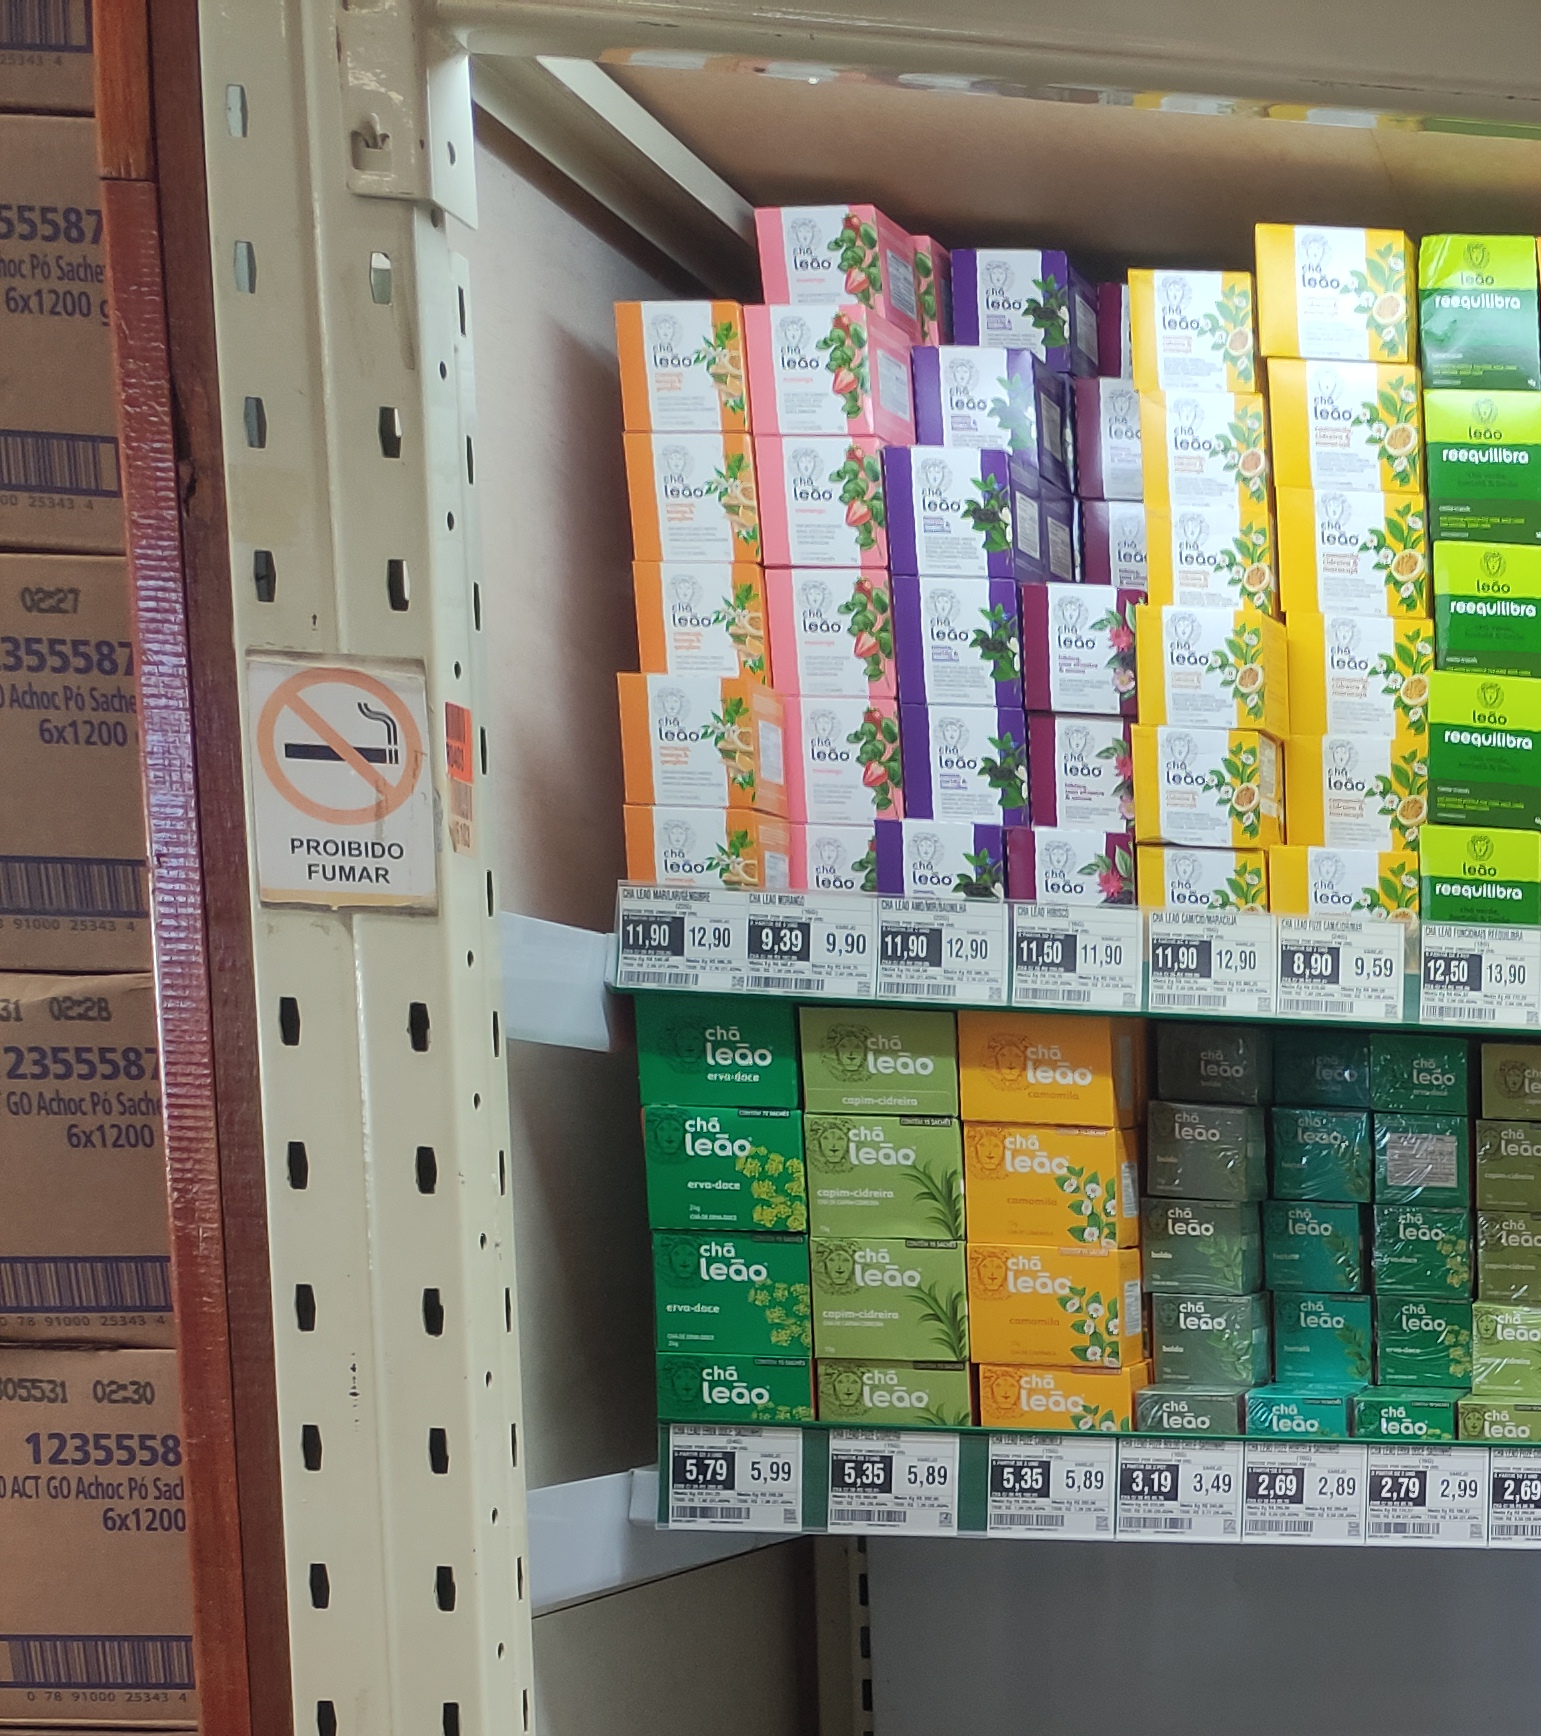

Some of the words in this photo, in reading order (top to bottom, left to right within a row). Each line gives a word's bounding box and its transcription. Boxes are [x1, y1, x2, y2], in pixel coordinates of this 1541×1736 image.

[1435, 295, 1520, 311] reequilibra
[40, 719, 127, 747] 6x1200
[290, 837, 404, 859] PROIBIDO
[307, 863, 391, 884] FUMAR
[625, 924, 670, 948] 11,90
[689, 926, 731, 950] 12,90
[1020, 940, 1062, 965] 11,50
[1082, 943, 1122, 968] 11,90
[1426, 960, 1469, 984] 12,50
[1486, 962, 1526, 987] 13,90
[705, 1025, 740, 1042] chá
[706, 1044, 772, 1066] leão
[25, 1433, 181, 1467] 1235558
[685, 1456, 728, 1484] 5,79
[749, 1460, 791, 1484] 5,99
[843, 1462, 884, 1486] 5,35
[906, 1464, 948, 1488] 5,89
[1380, 1477, 1420, 1502] 2,79
[1440, 1478, 1478, 1502] 2,99
[102, 1508, 186, 1532] 6x1200
